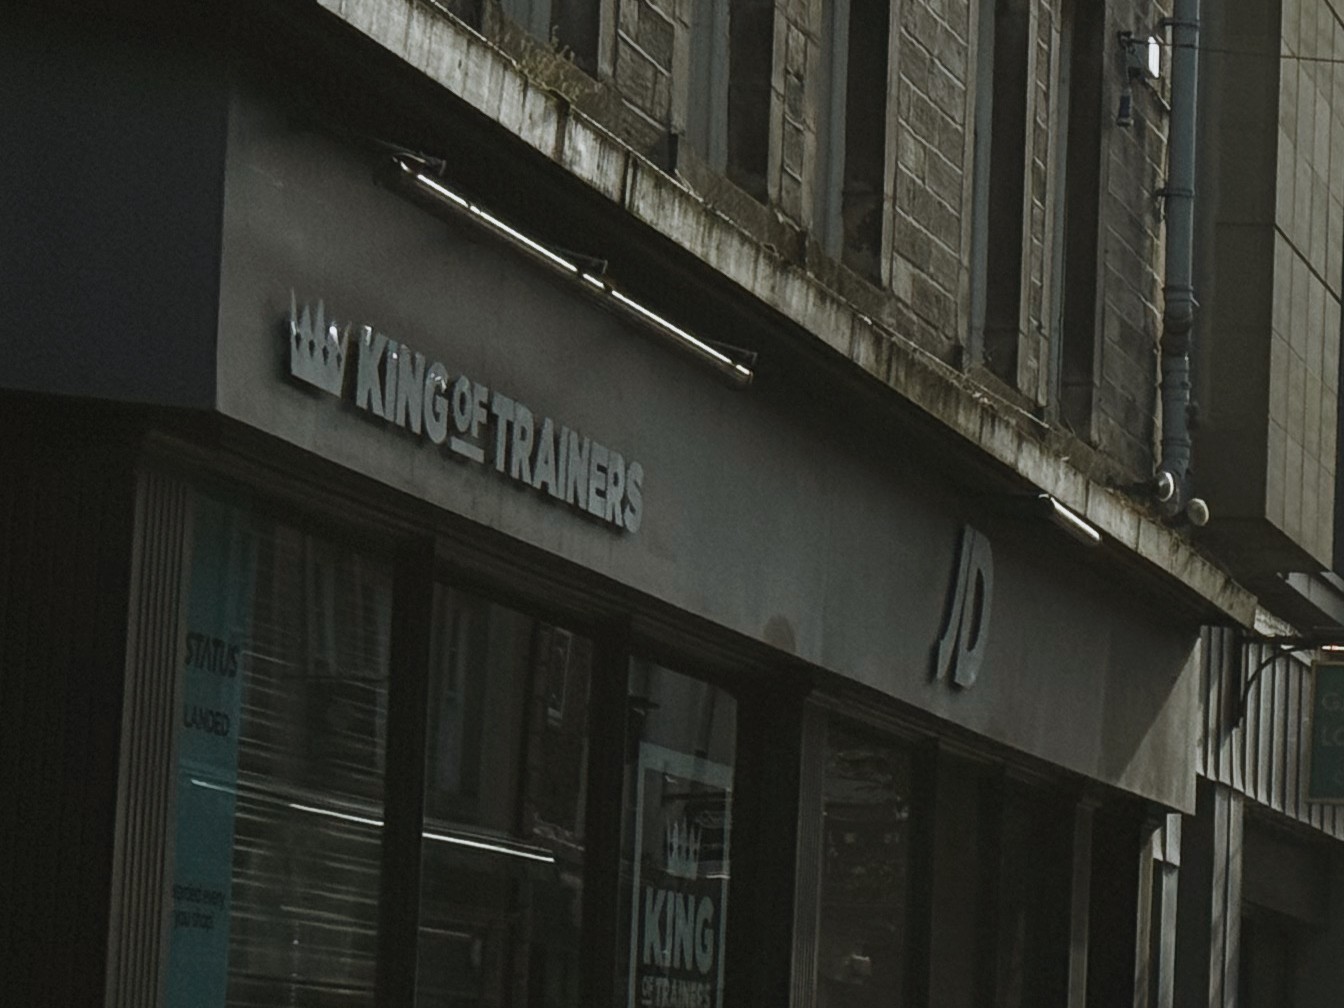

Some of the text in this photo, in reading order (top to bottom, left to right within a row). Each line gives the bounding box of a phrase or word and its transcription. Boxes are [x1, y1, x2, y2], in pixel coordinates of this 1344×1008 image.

[355, 323, 644, 534] KING OF TRAINERS
[186, 632, 239, 679] STATUS
[937, 523, 994, 690] JD
[642, 885, 715, 975] KING
